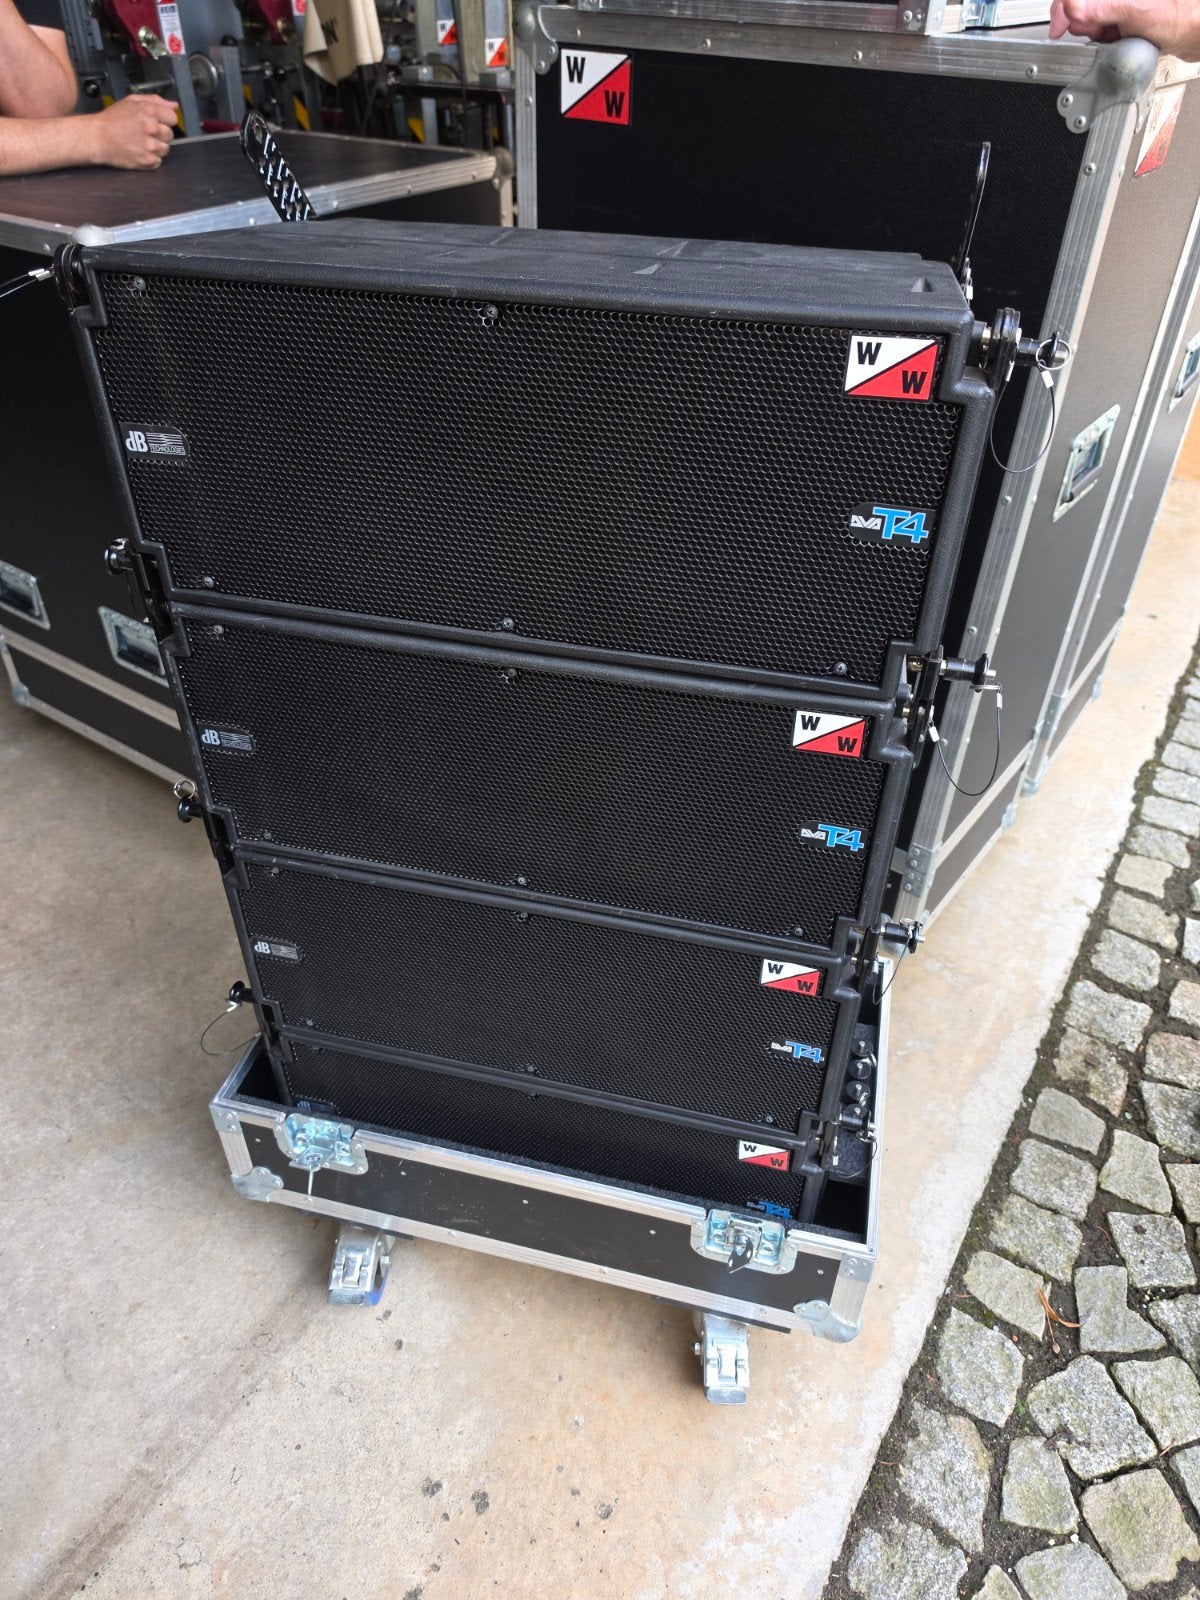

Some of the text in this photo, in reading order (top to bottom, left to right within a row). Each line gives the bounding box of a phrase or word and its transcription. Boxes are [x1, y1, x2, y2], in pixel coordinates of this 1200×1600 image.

[566, 55, 586, 84] W
[604, 90, 625, 118] W
[857, 341, 882, 365] W
[902, 370, 927, 394] W
[125, 430, 148, 452] dB
[872, 506, 929, 544] T4
[801, 714, 821, 731] W
[201, 729, 221, 746] dB
[837, 736, 858, 753] W
[818, 823, 865, 852] T4
[254, 941, 271, 954] dB
[767, 962, 784, 975] W
[797, 980, 814, 992] W
[785, 1041, 825, 1063] T4
[743, 1143, 757, 1152] W
[770, 1158, 784, 1167] W
